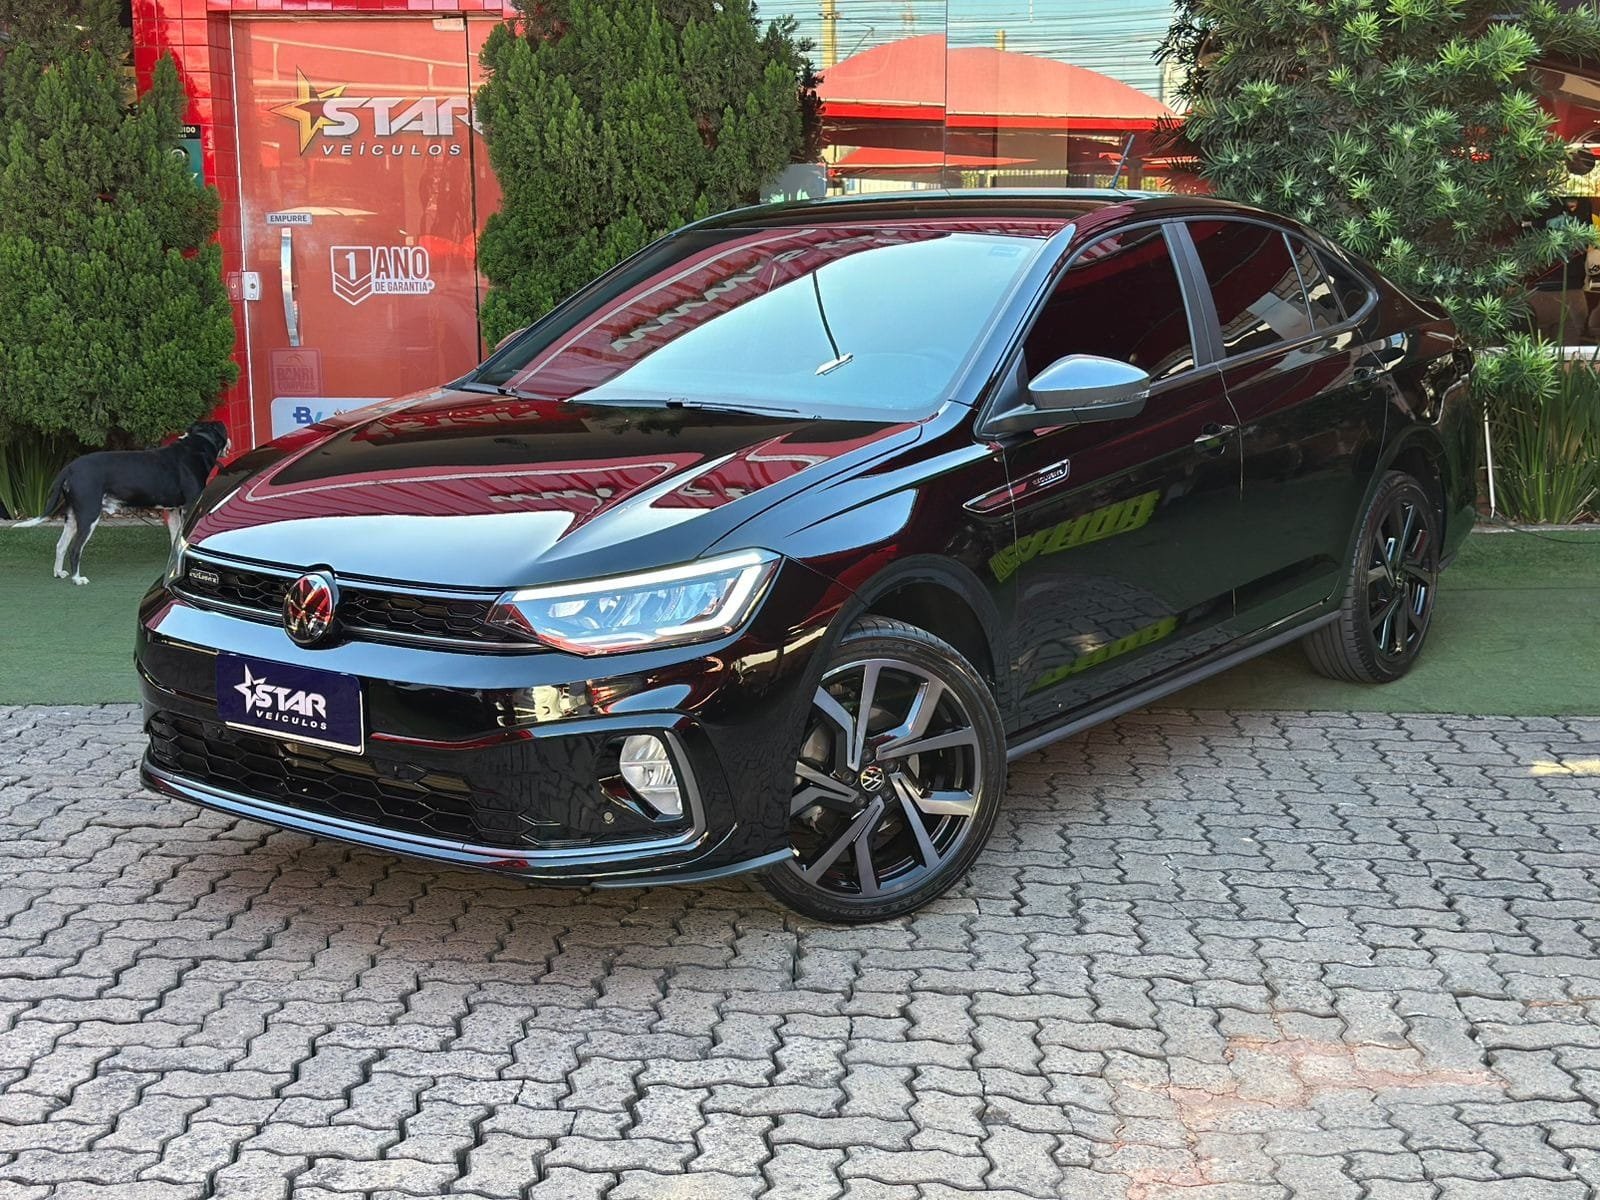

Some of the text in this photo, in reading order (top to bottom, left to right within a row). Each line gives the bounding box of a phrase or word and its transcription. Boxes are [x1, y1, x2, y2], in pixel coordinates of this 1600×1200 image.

[322, 142, 462, 156] VEÍCULOS
[270, 214, 308, 223] EMPURRE
[345, 246, 430, 280] 1 ANO
[375, 281, 428, 292] DE GARANTIA
[255, 684, 327, 719] STAR
[256, 709, 328, 730] VEÍCULOS
